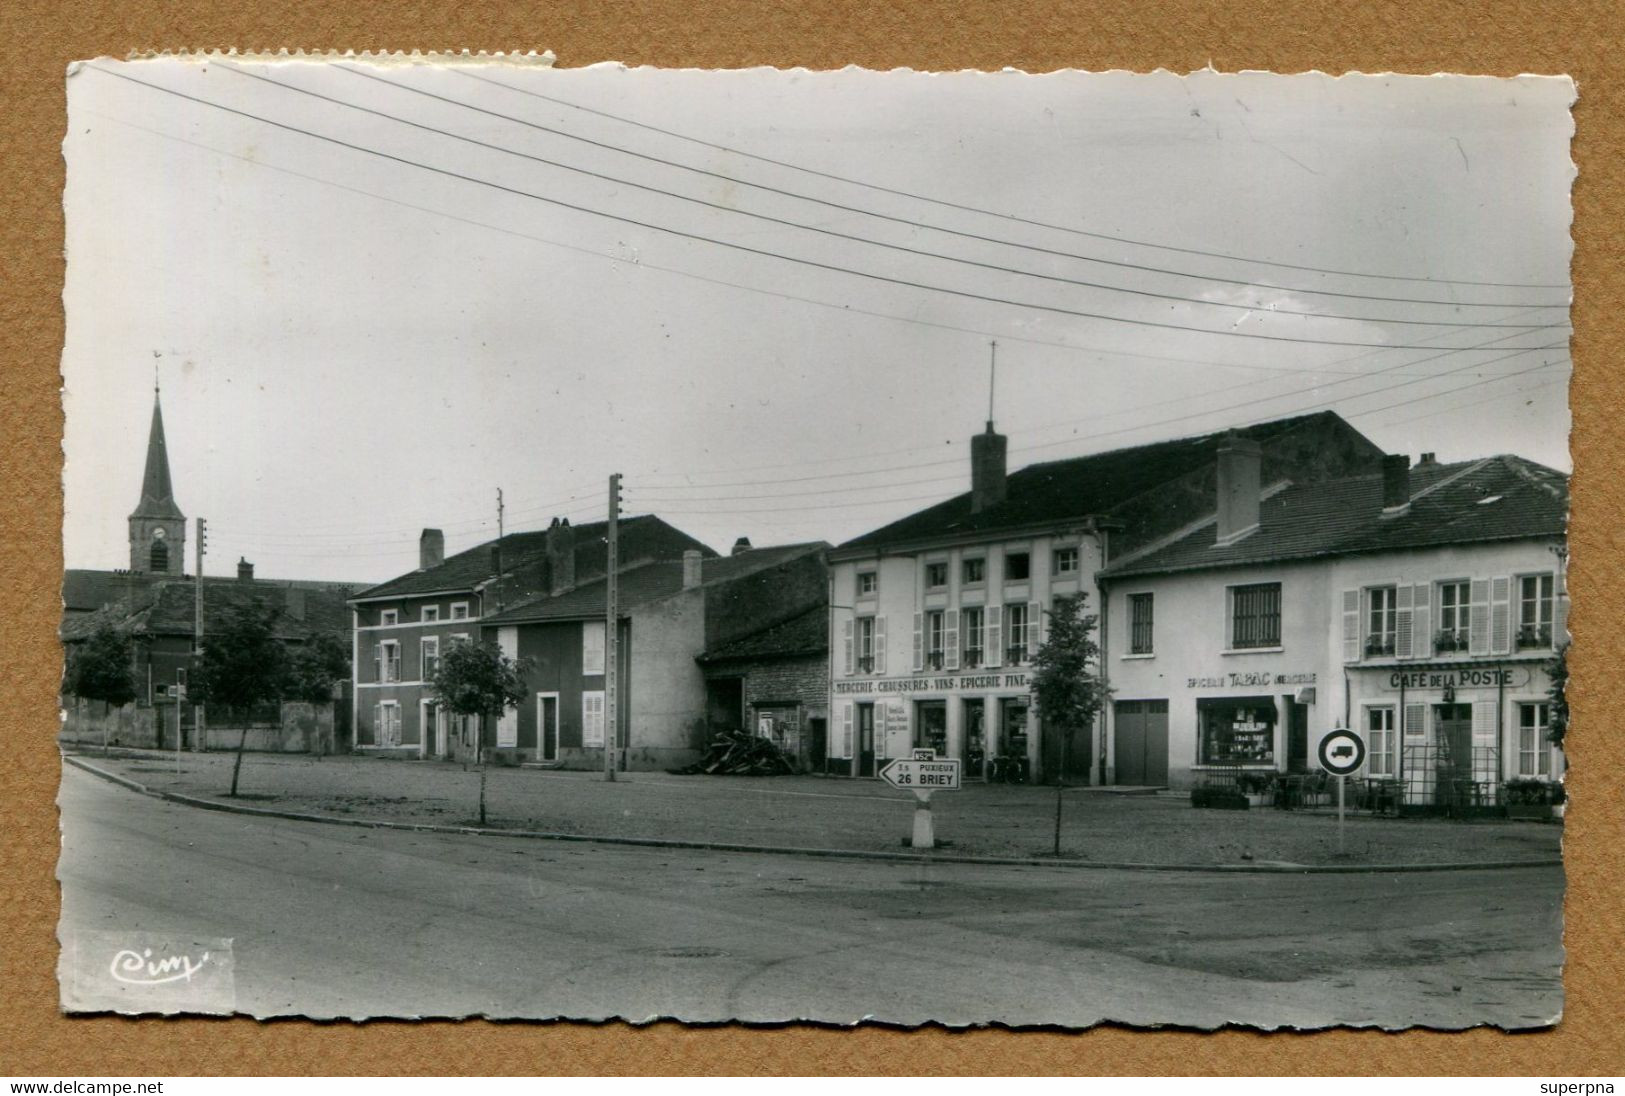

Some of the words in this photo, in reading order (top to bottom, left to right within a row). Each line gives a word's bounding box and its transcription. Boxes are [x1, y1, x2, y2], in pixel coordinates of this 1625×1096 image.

[836, 682, 873, 694] MERCERIE
[878, 680, 928, 692] CHAUSSURES
[934, 679, 954, 689] VINS
[960, 675, 1000, 689] EPICERIE
[1005, 675, 1025, 687] FINE
[1228, 672, 1270, 687] TABAC
[1430, 675, 1442, 687] DE
[1444, 674, 1455, 686] LA
[1459, 670, 1513, 686] POSTE
[898, 774, 912, 784] 26
[920, 774, 953, 785] BRIEY
